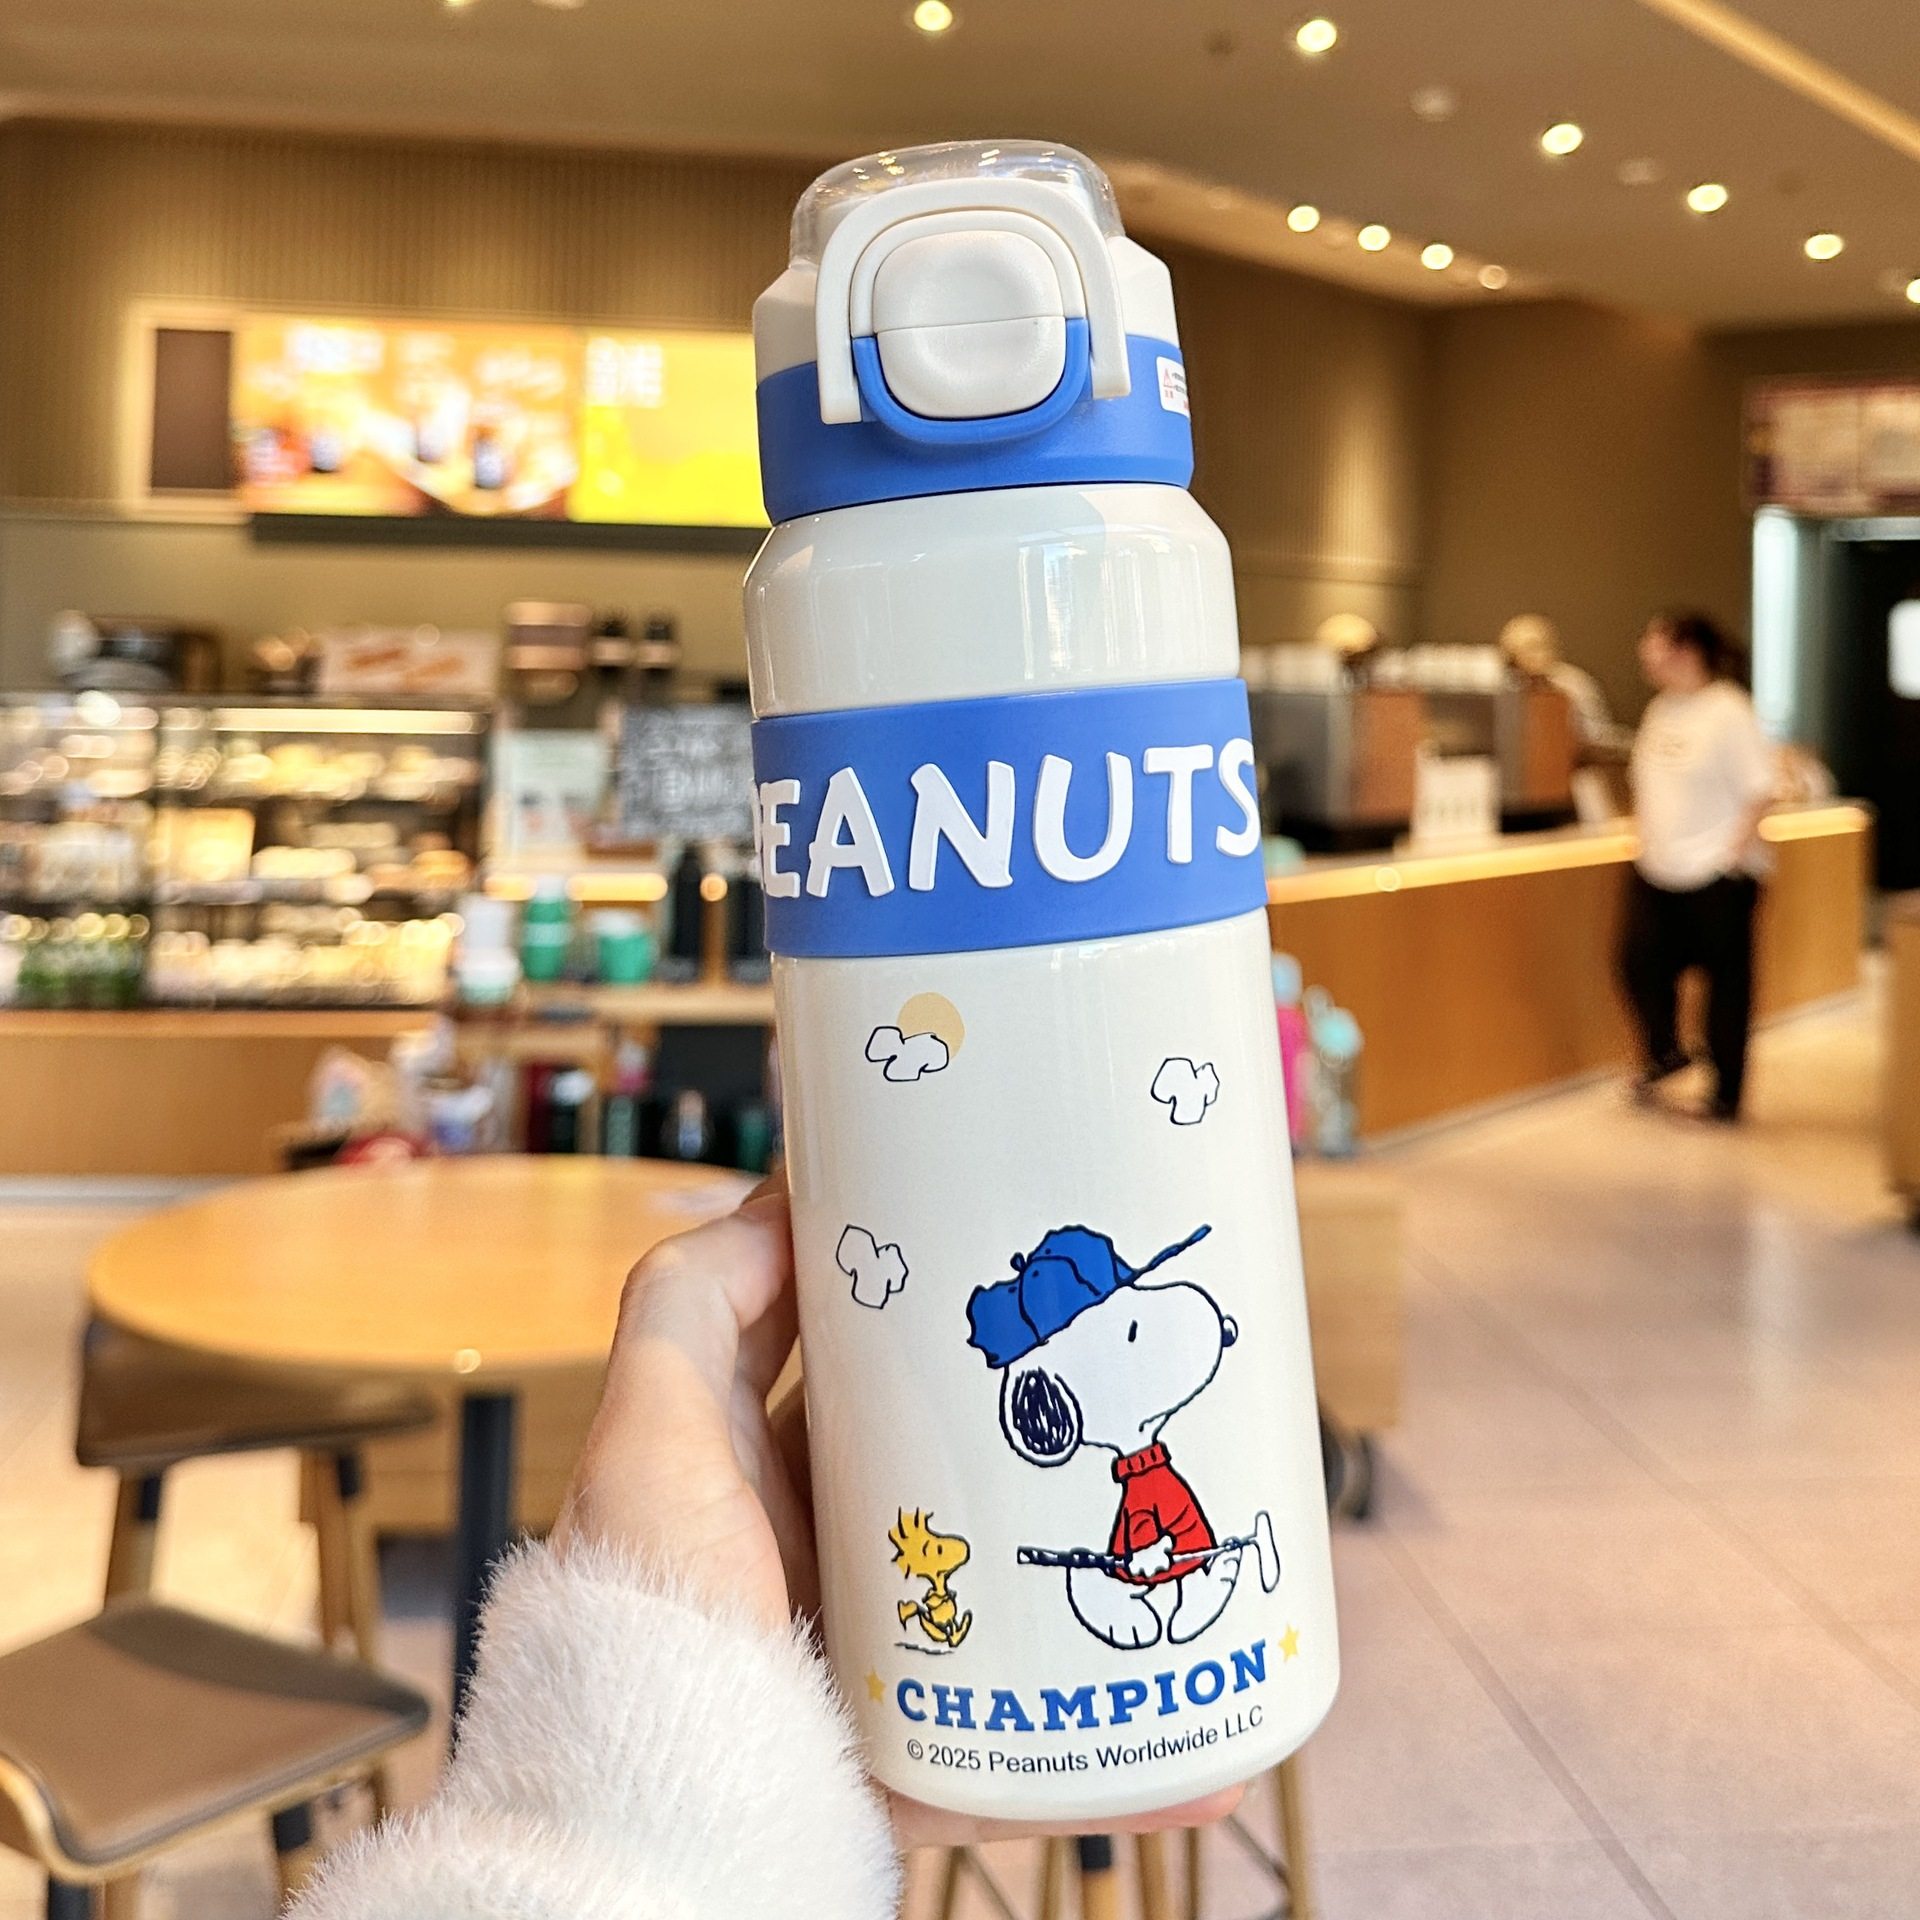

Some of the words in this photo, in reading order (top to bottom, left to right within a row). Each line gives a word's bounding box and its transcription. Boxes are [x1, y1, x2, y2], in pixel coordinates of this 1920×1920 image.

[753, 738, 1261, 899] EANUTS
[896, 1638, 1267, 1732] CHAMPION
[928, 1744, 981, 1771] 2025
[989, 1750, 1088, 1773] Peanuts
[1096, 1726, 1219, 1768] Worldwide
[1225, 1705, 1264, 1738] LLC
